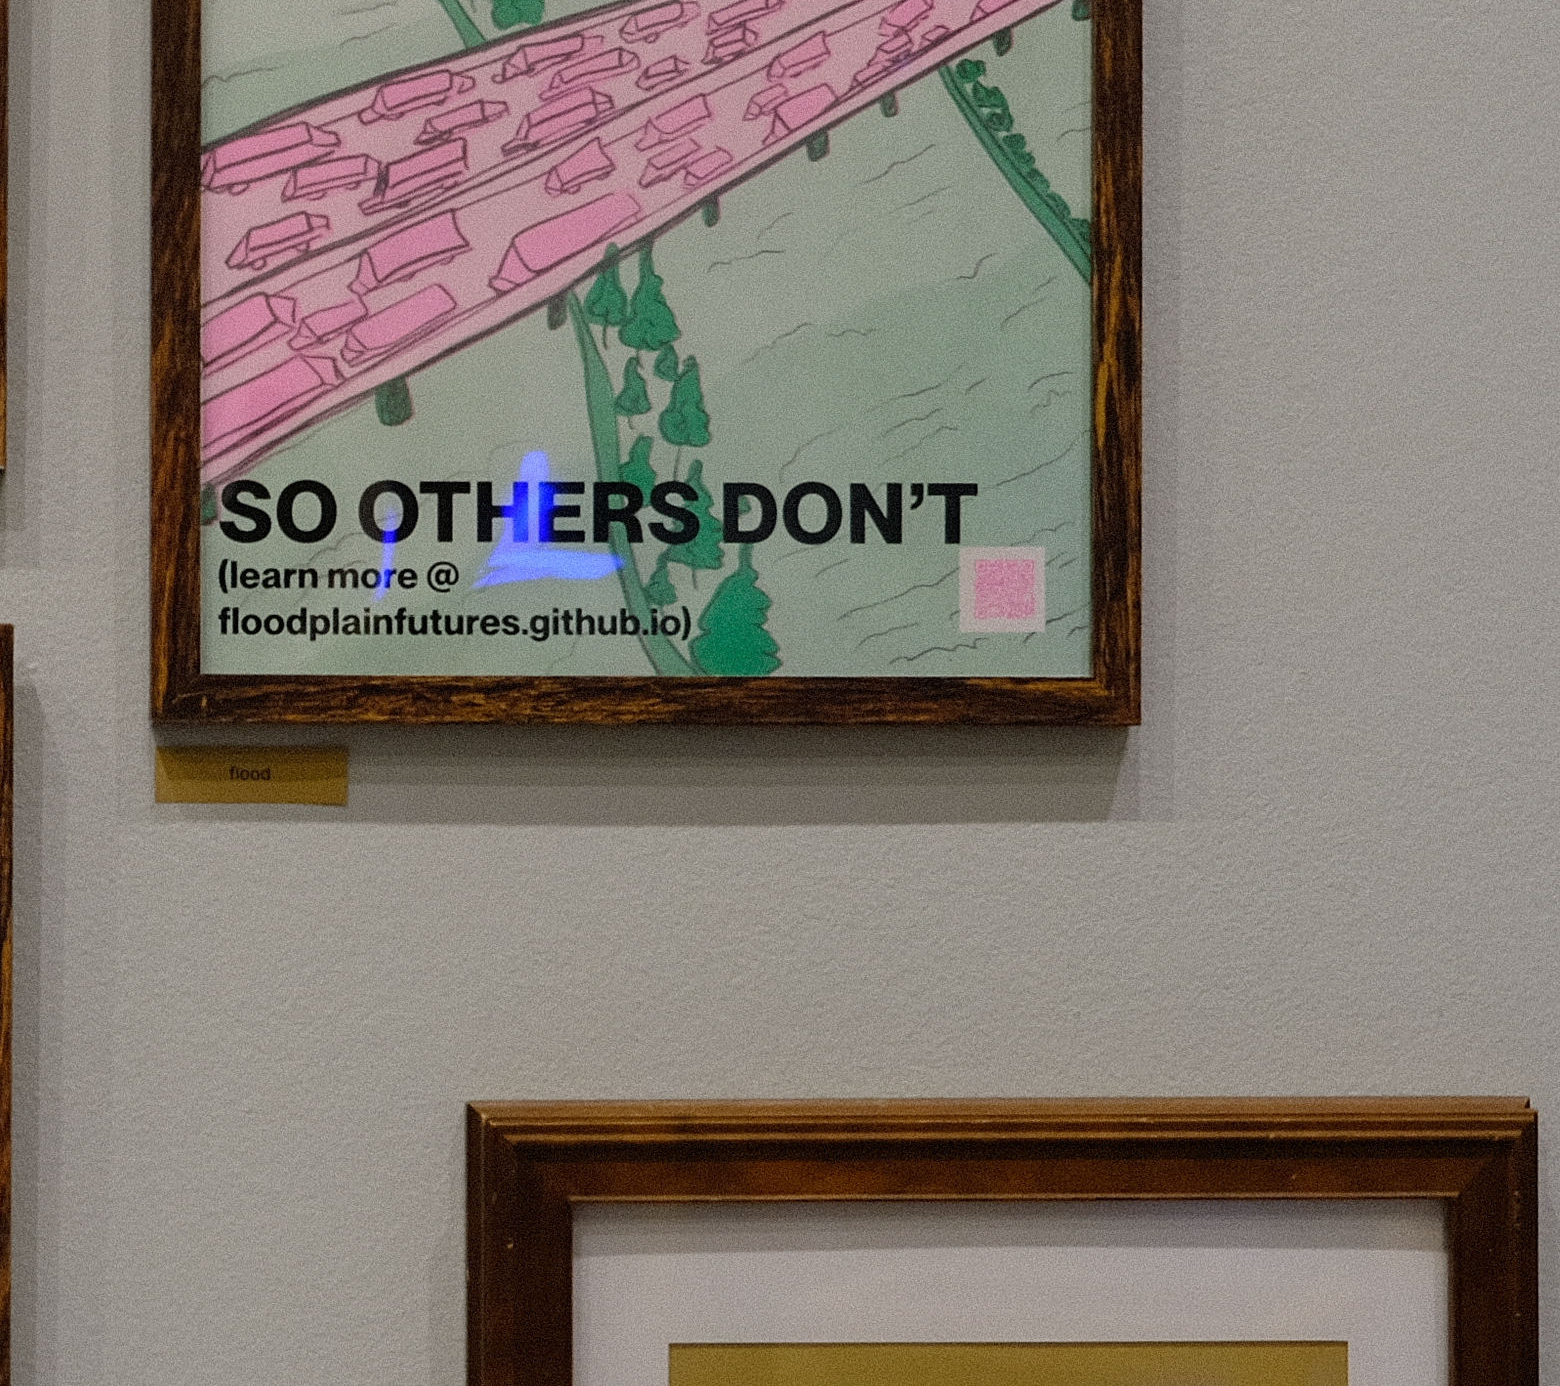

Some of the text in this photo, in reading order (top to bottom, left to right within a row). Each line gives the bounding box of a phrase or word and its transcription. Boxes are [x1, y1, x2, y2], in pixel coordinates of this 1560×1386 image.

[220, 480, 978, 545] SO OTHERS DON’T
[218, 559, 460, 594] (learn more @
[218, 606, 691, 642] floodplainfutures.github.io)
[229, 765, 270, 781] flood
